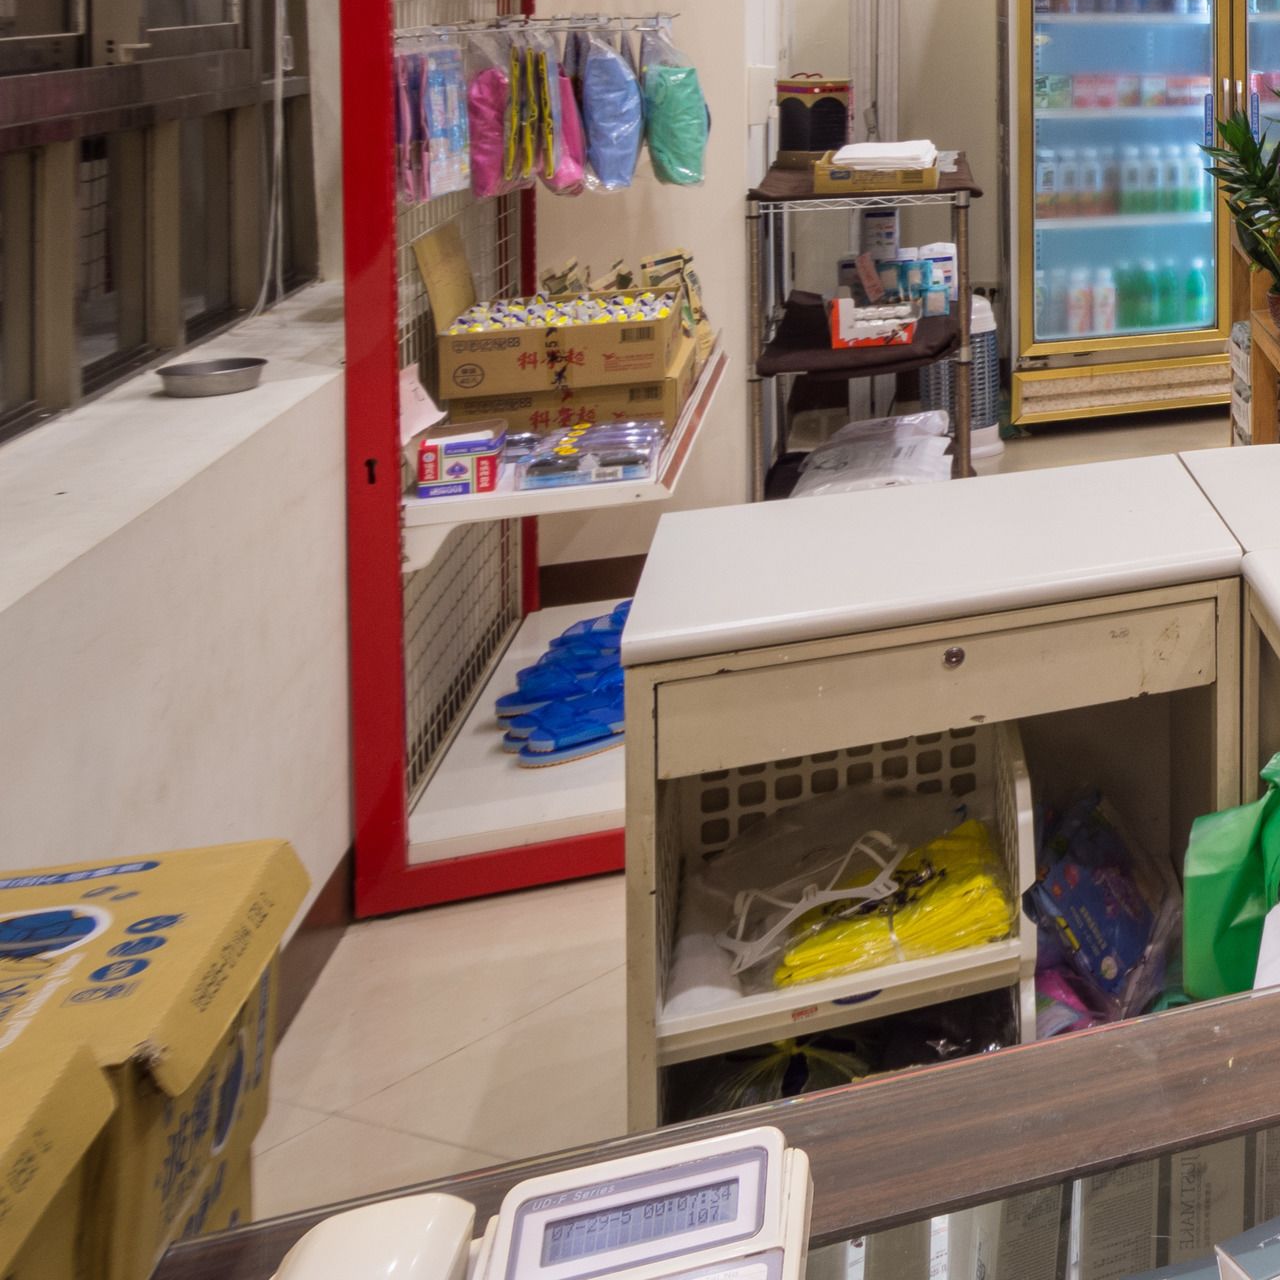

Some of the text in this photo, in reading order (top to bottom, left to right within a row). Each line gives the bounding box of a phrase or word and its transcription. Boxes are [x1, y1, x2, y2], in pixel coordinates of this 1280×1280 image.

[532, 1183, 616, 1211] UD-F Series
[688, 1205, 721, 1227] 107
